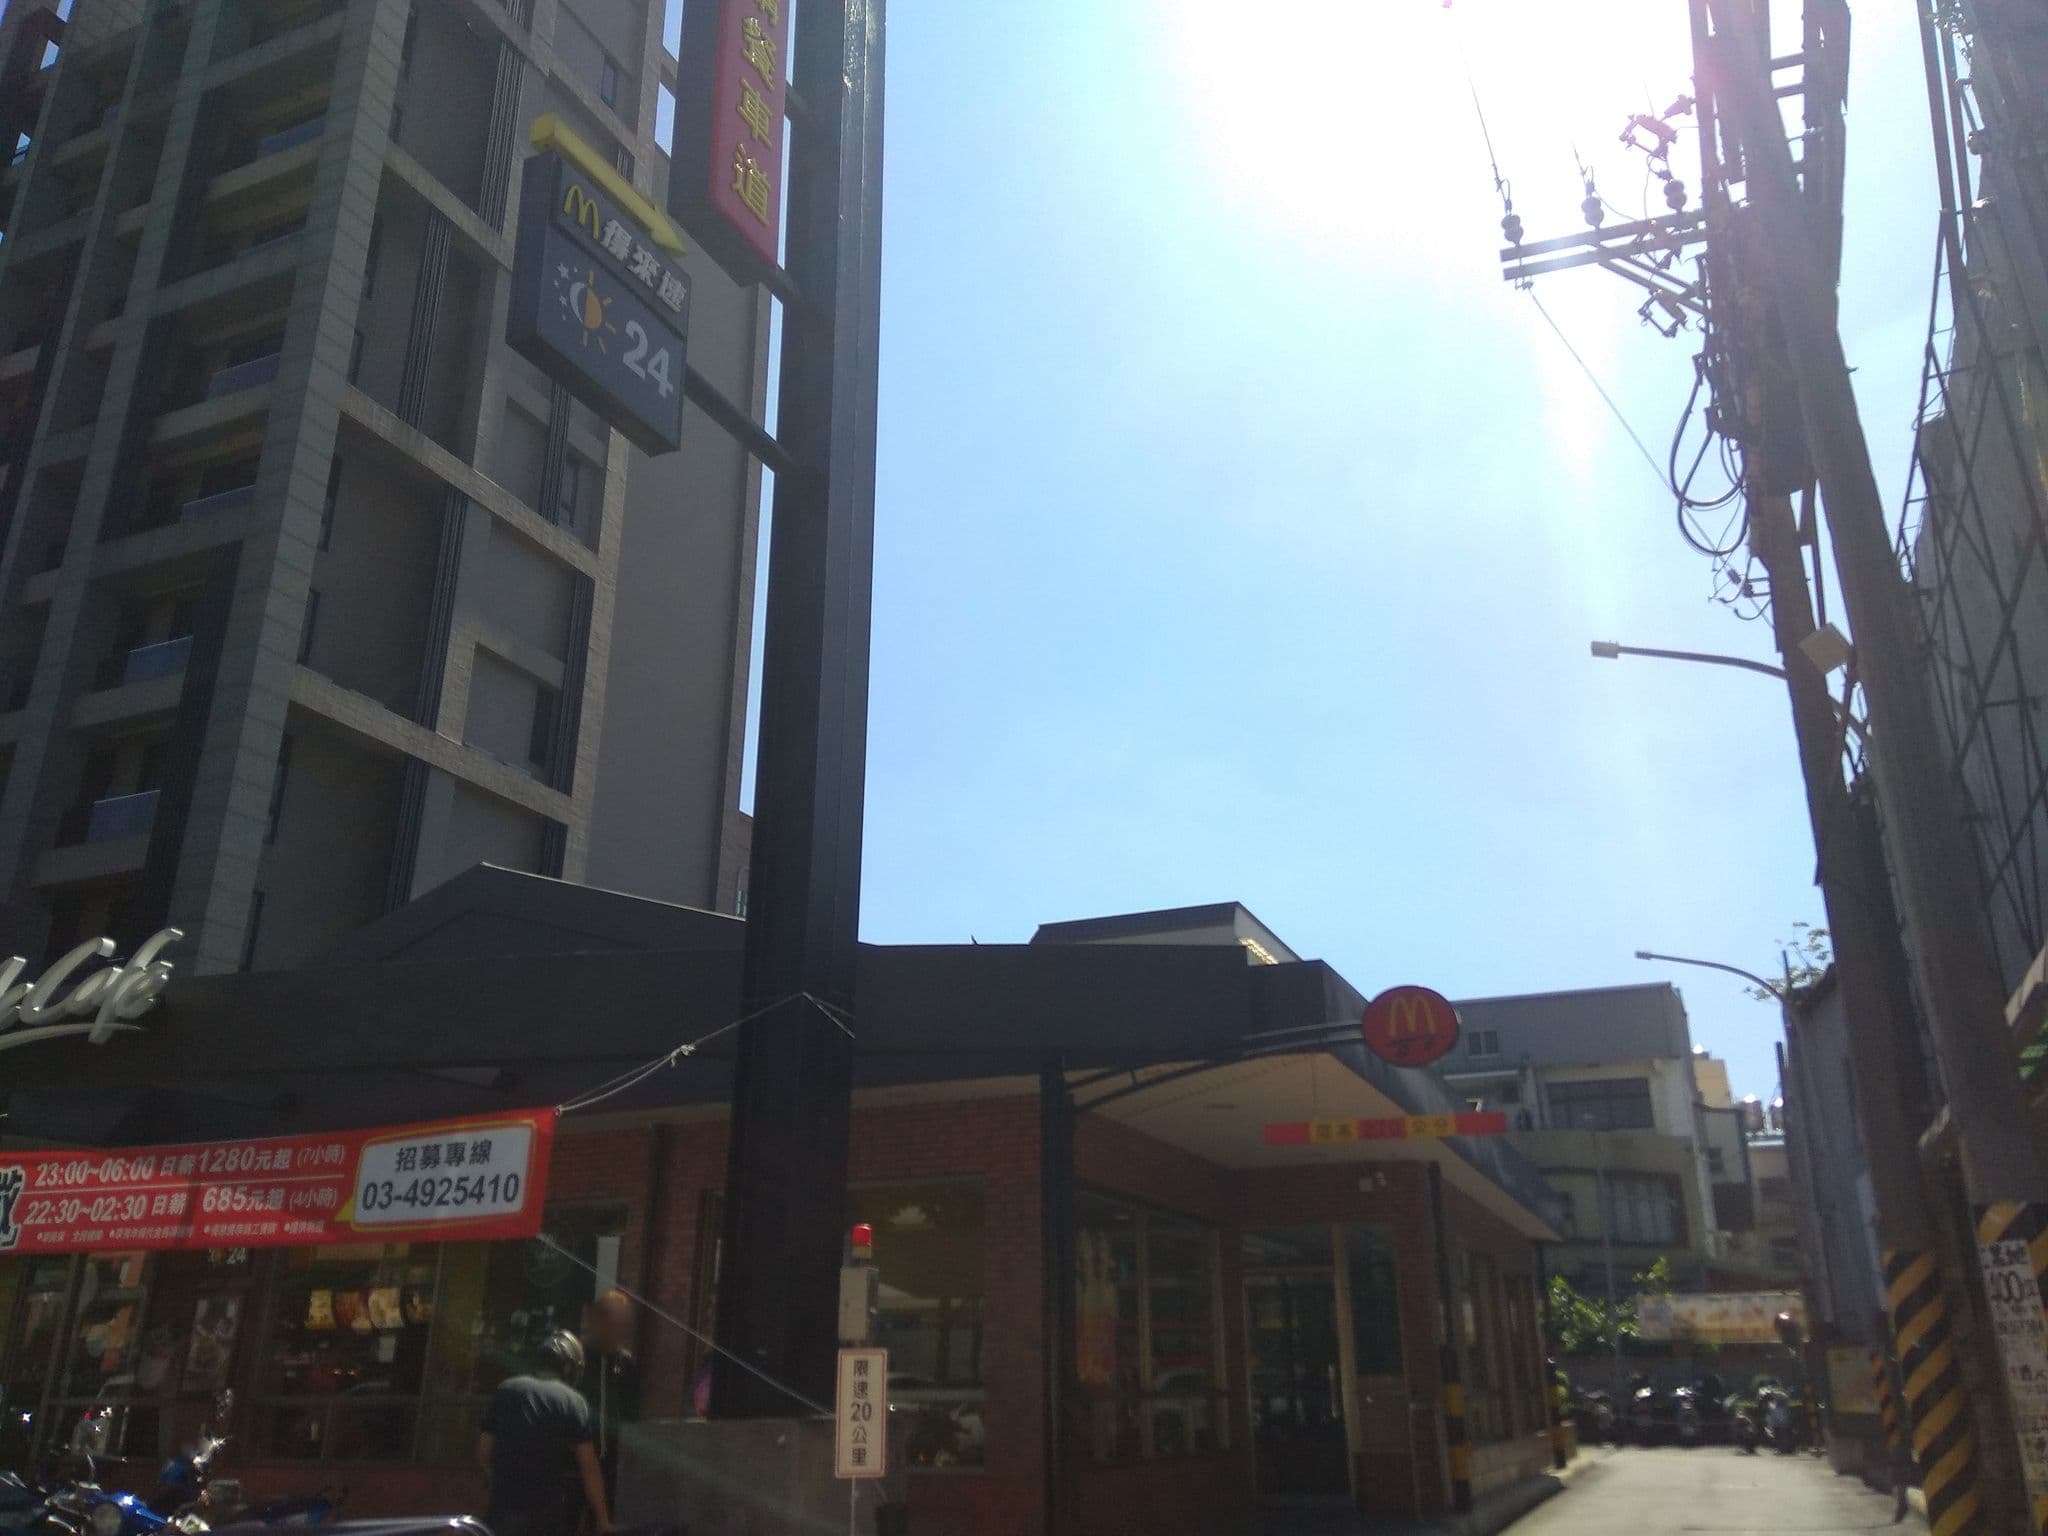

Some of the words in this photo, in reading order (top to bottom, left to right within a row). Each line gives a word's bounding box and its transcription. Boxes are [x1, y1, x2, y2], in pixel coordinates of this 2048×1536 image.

[600, 220, 687, 313] 得來速
[623, 320, 674, 398] 24
[35, 1156, 155, 1187] 23:00~06:00
[160, 1153, 196, 1177] 日薪
[394, 1139, 494, 1173] 招募專線
[23, 1194, 147, 1225] 22:30~02:30
[151, 1192, 188, 1216] 日薪
[362, 1173, 520, 1211] 03-4925410
